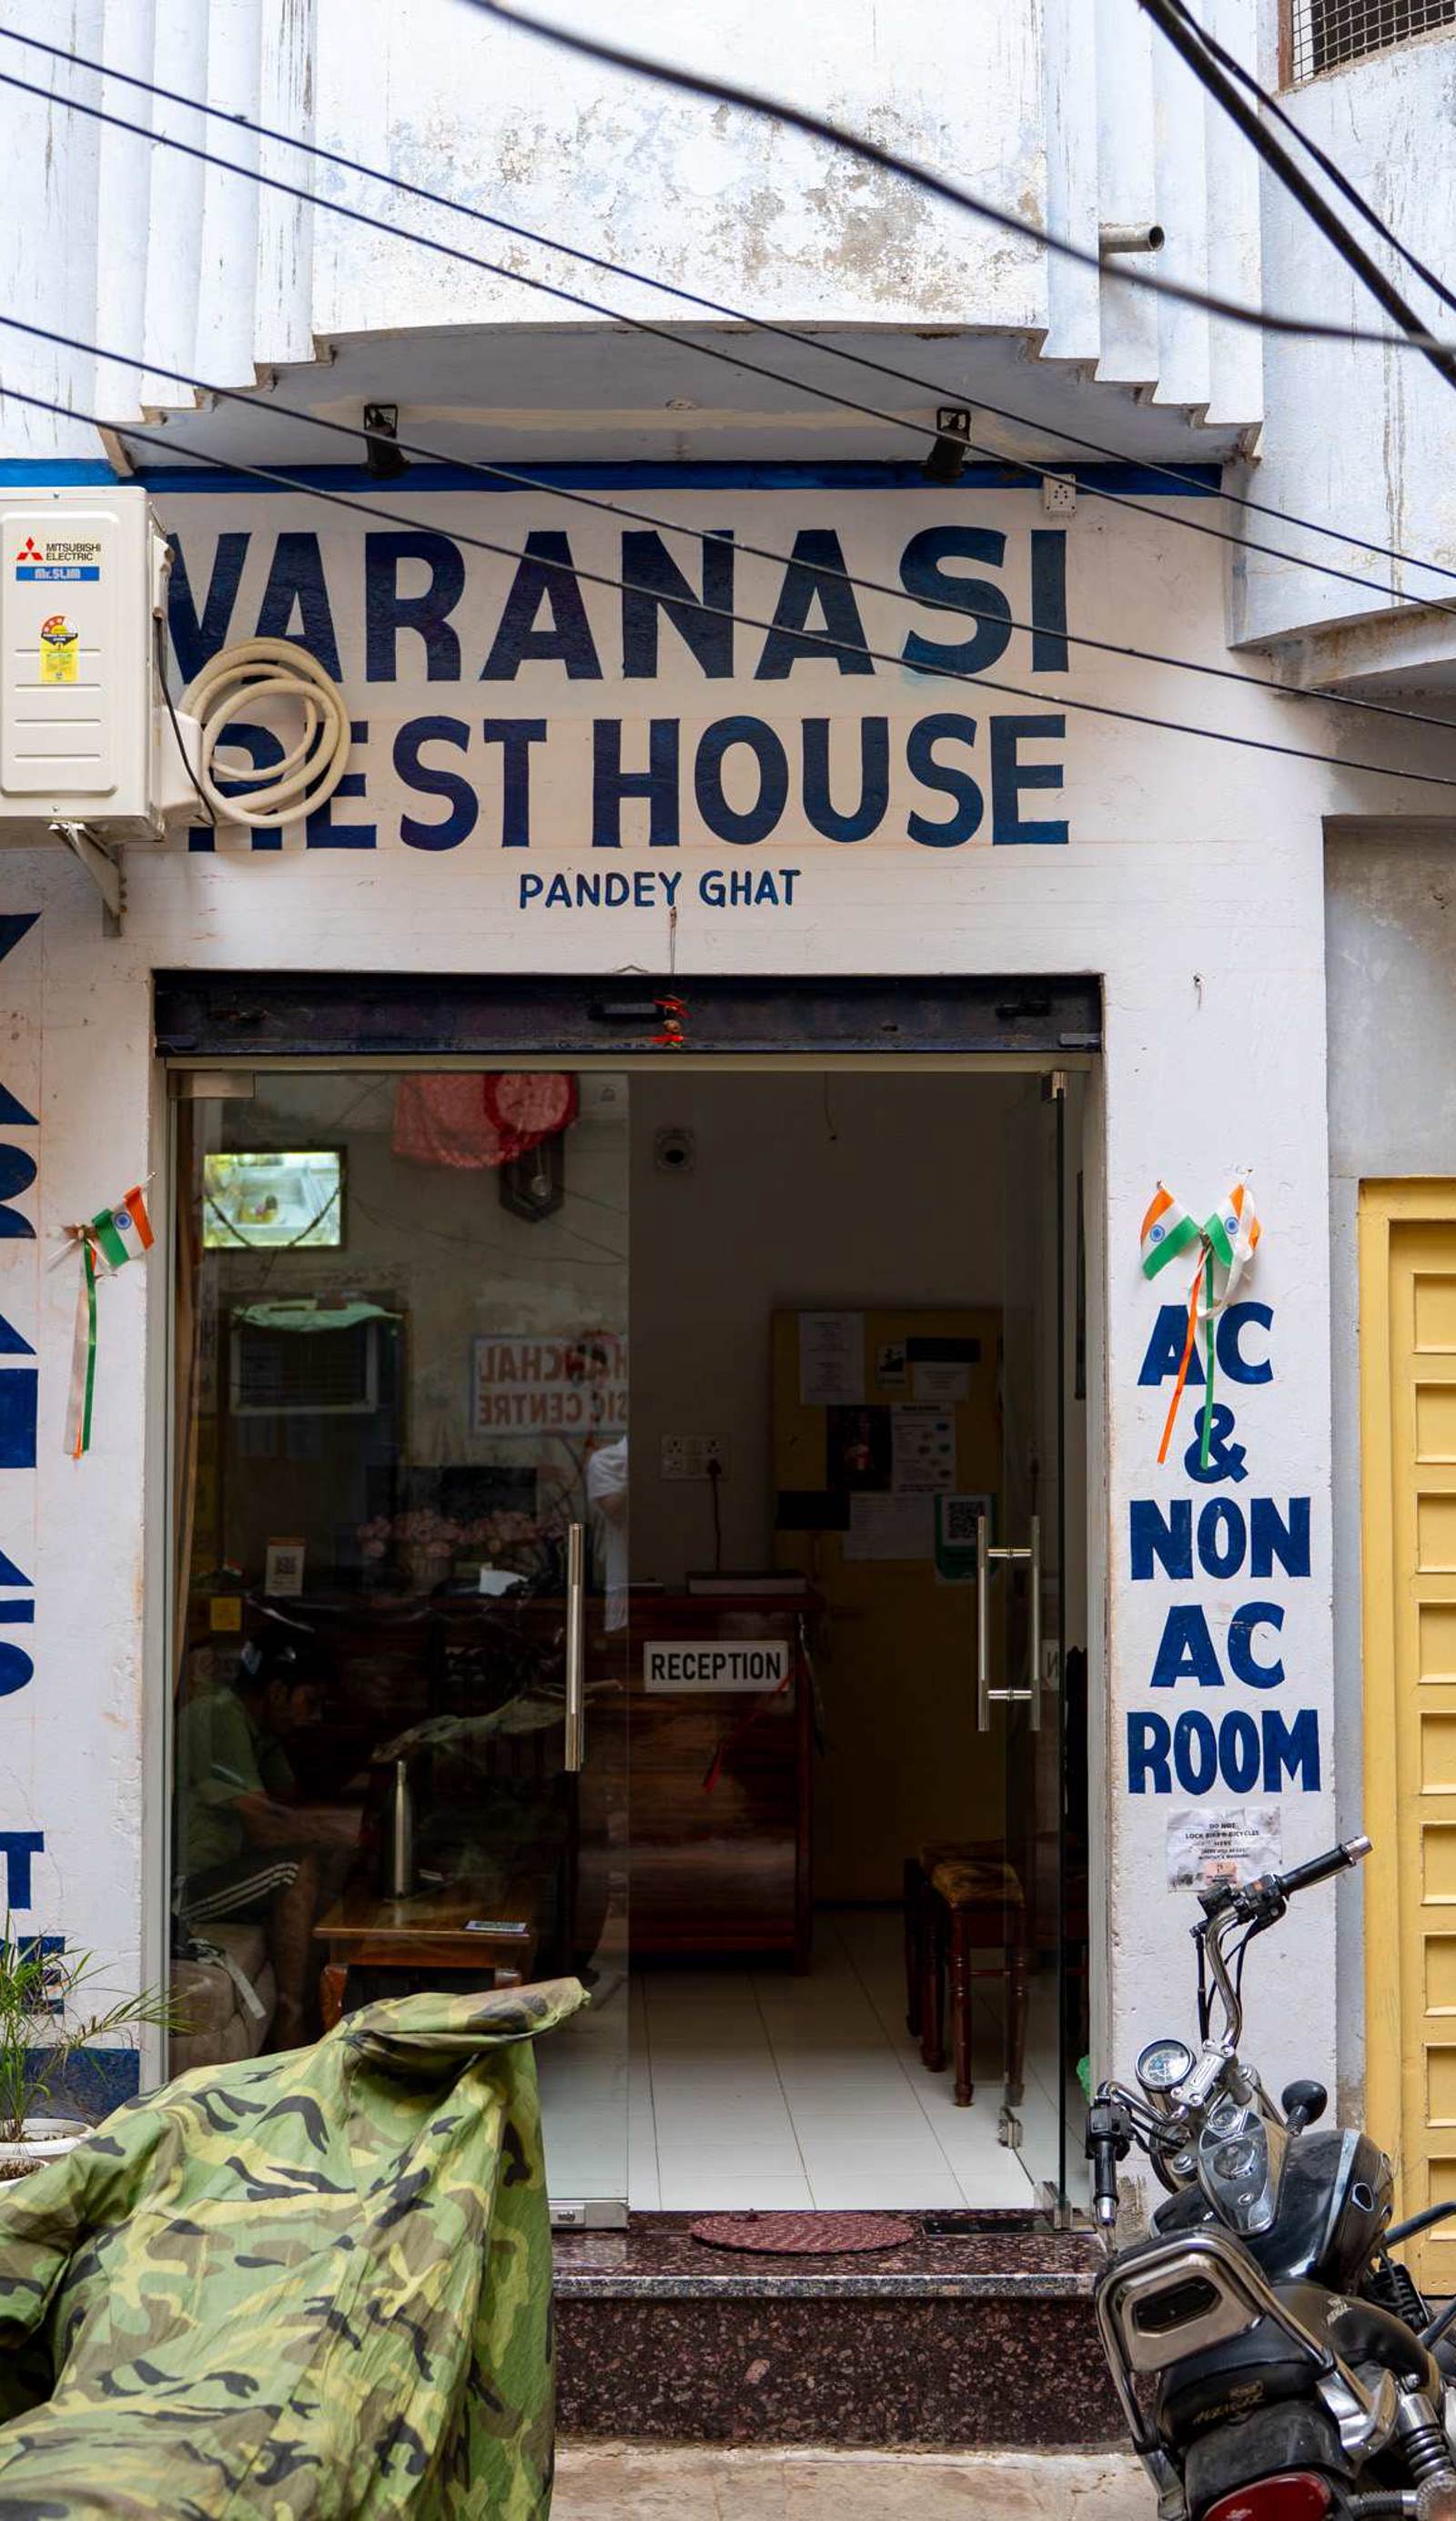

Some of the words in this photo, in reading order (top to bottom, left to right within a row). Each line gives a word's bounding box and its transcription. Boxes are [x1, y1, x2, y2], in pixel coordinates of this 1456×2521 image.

[46, 542, 102, 553] MITSUBISHI
[46, 552, 94, 562] ELECTRIC
[167, 525, 1070, 684] VARANASI
[592, 713, 1069, 849] HOUSE
[520, 871, 682, 909] PANDEY
[699, 869, 802, 908] GHAT
[1138, 1301, 1274, 1386] AC
[1184, 1402, 1249, 1484] &
[1129, 1497, 1311, 1581] NON
[652, 1652, 781, 1680] RECEPTION
[1149, 1602, 1286, 1690] AC
[1127, 1709, 1321, 1796] ROOM
